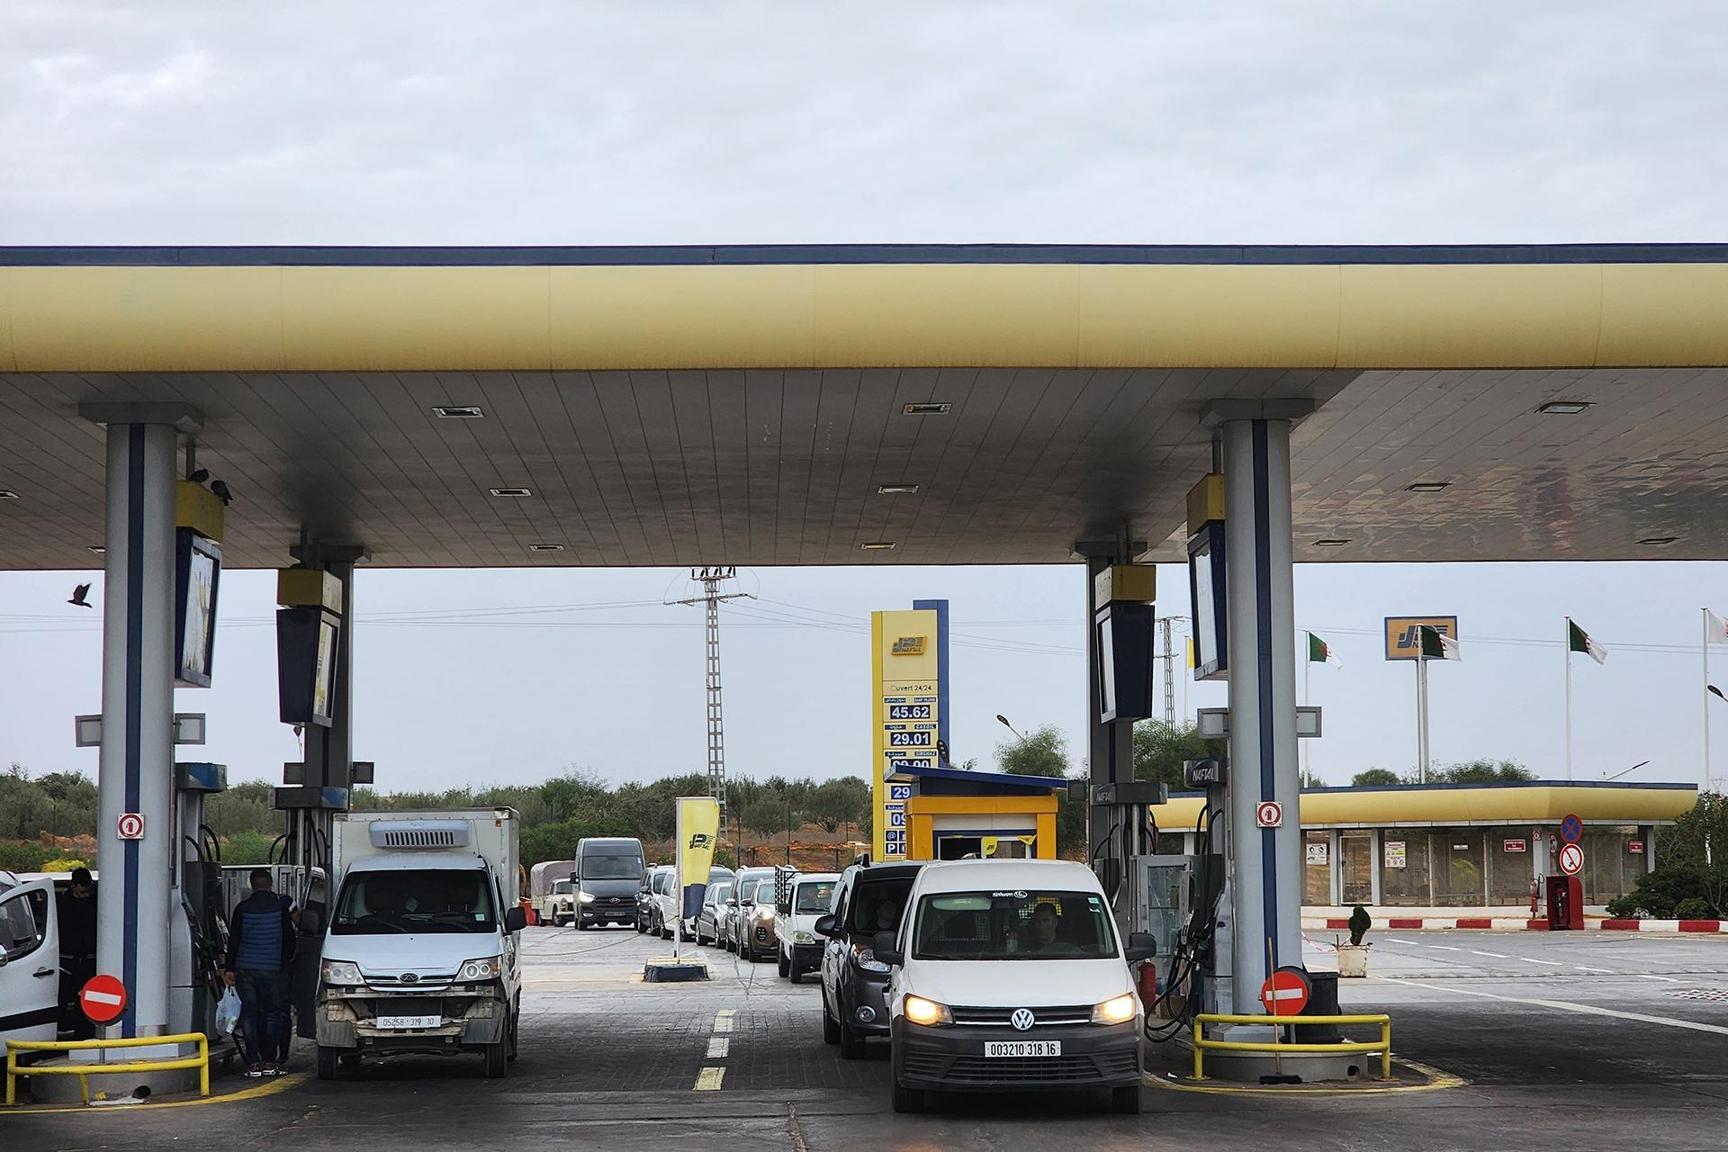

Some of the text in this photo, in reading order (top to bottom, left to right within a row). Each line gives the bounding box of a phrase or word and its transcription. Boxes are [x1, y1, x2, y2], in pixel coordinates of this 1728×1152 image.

[892, 706, 930, 718] 45.62
[893, 733, 929, 745] 29.01
[1192, 768, 1214, 781] NAFTAL
[893, 787, 910, 798] 29
[892, 813, 906, 825] 09
[990, 1042, 1056, 1056] 003210 318 16
